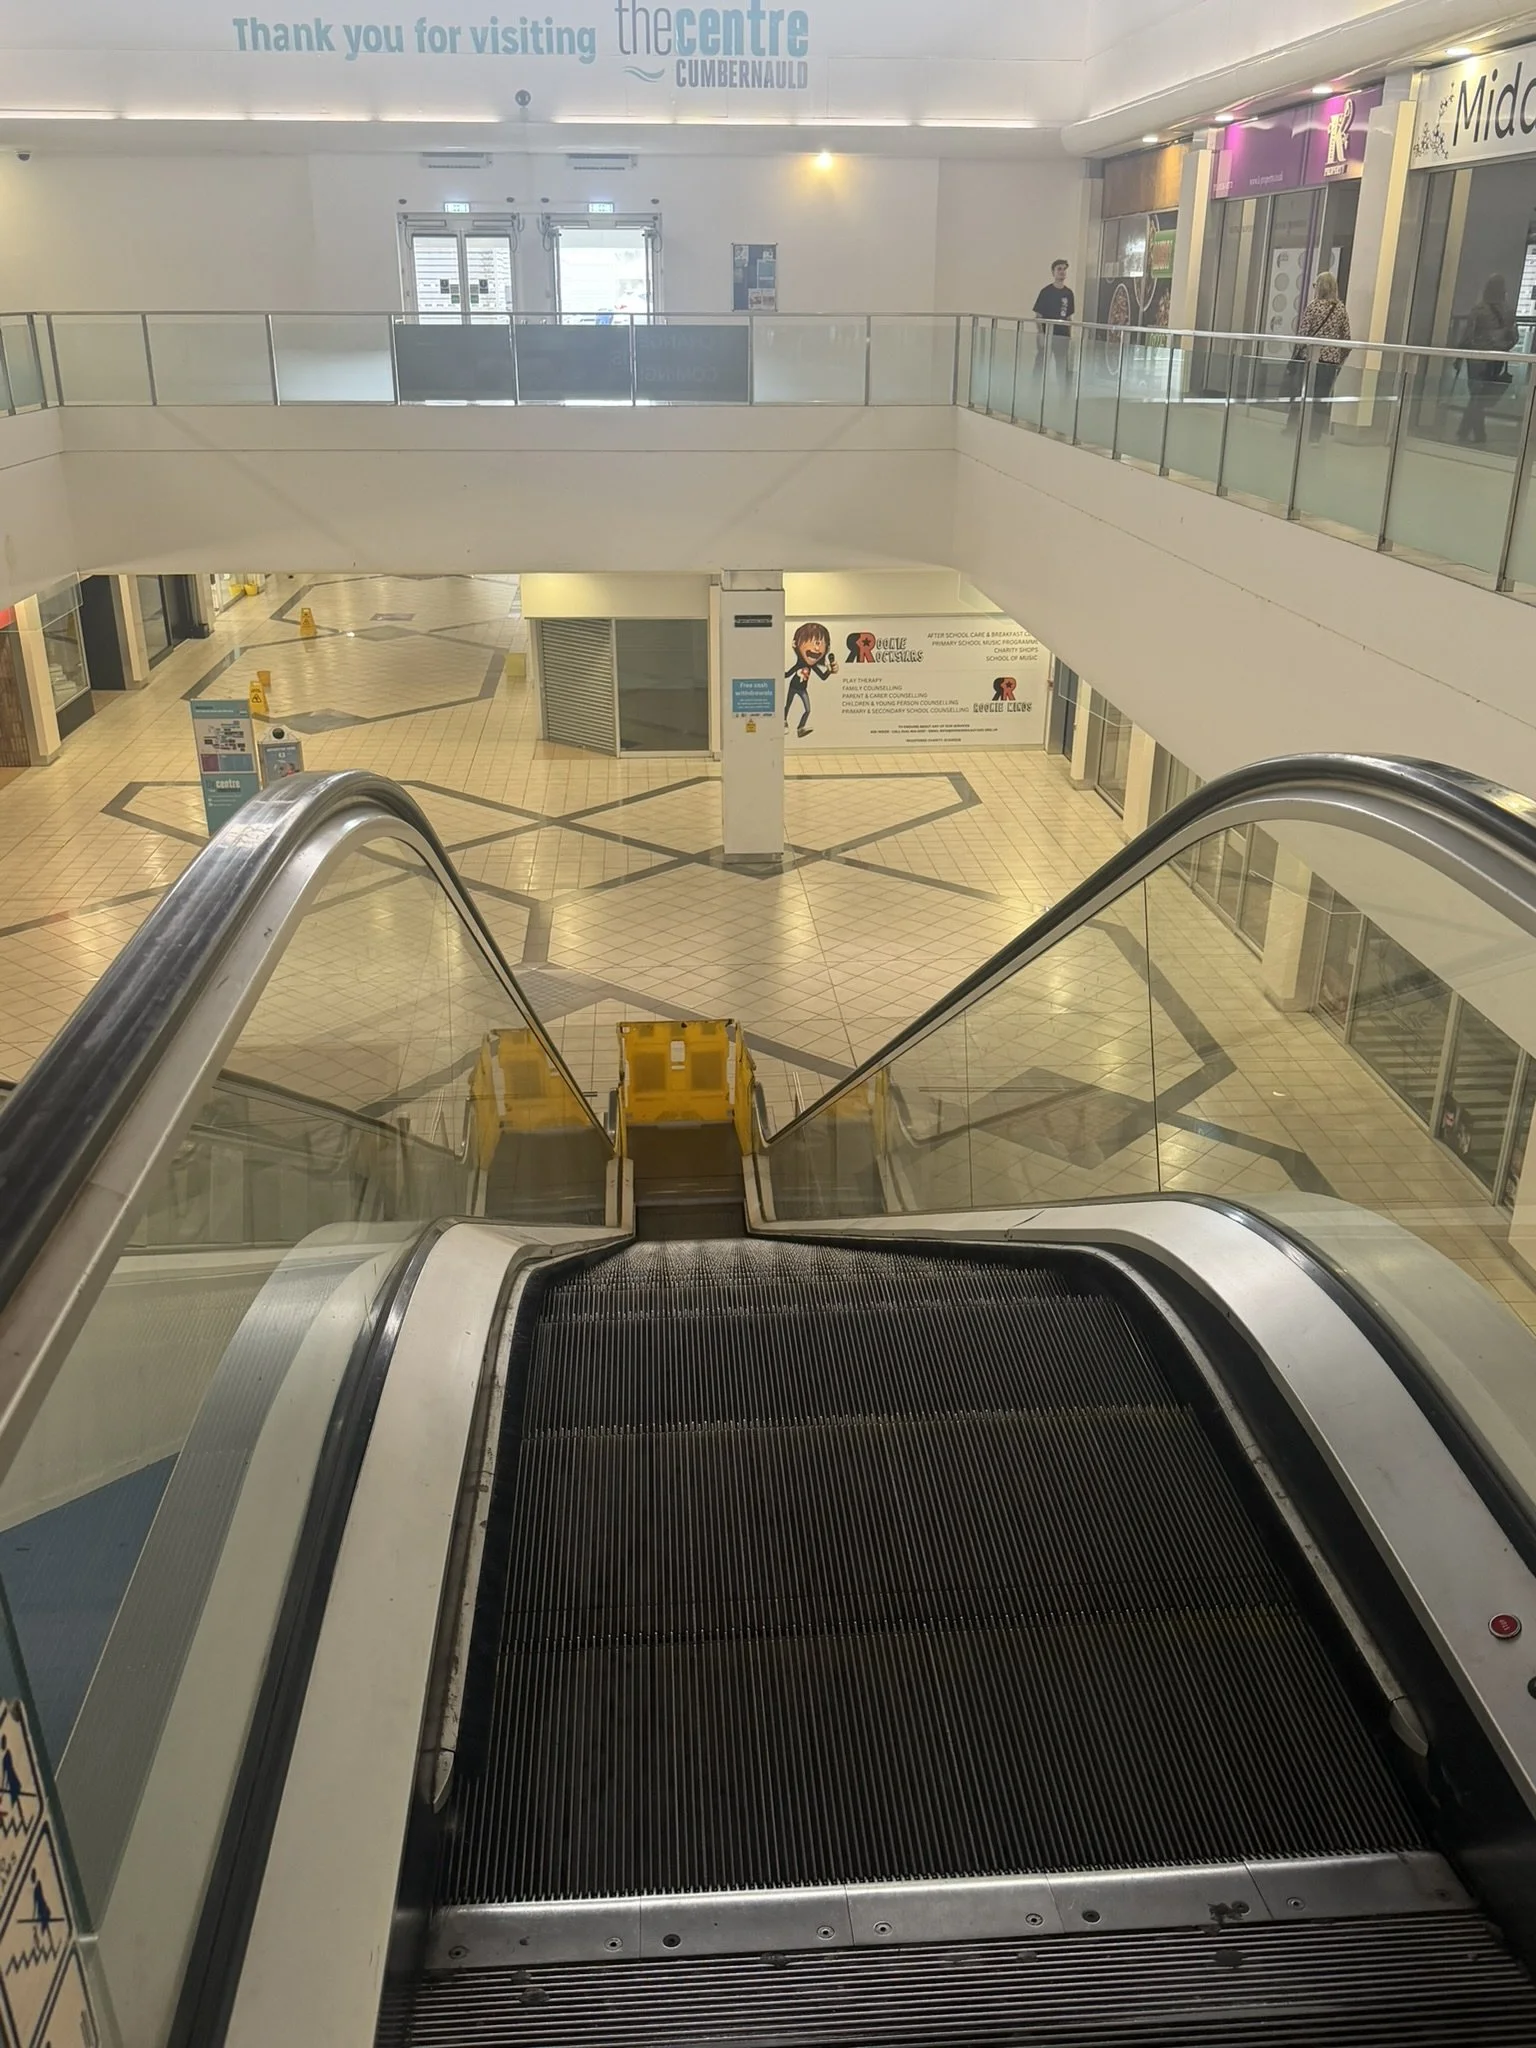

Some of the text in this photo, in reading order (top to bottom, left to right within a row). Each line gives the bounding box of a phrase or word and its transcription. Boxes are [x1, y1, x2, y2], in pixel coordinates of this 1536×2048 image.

[233, 16, 596, 64] Thank you for visiting
[675, 59, 808, 89] CUMBERNAULD
